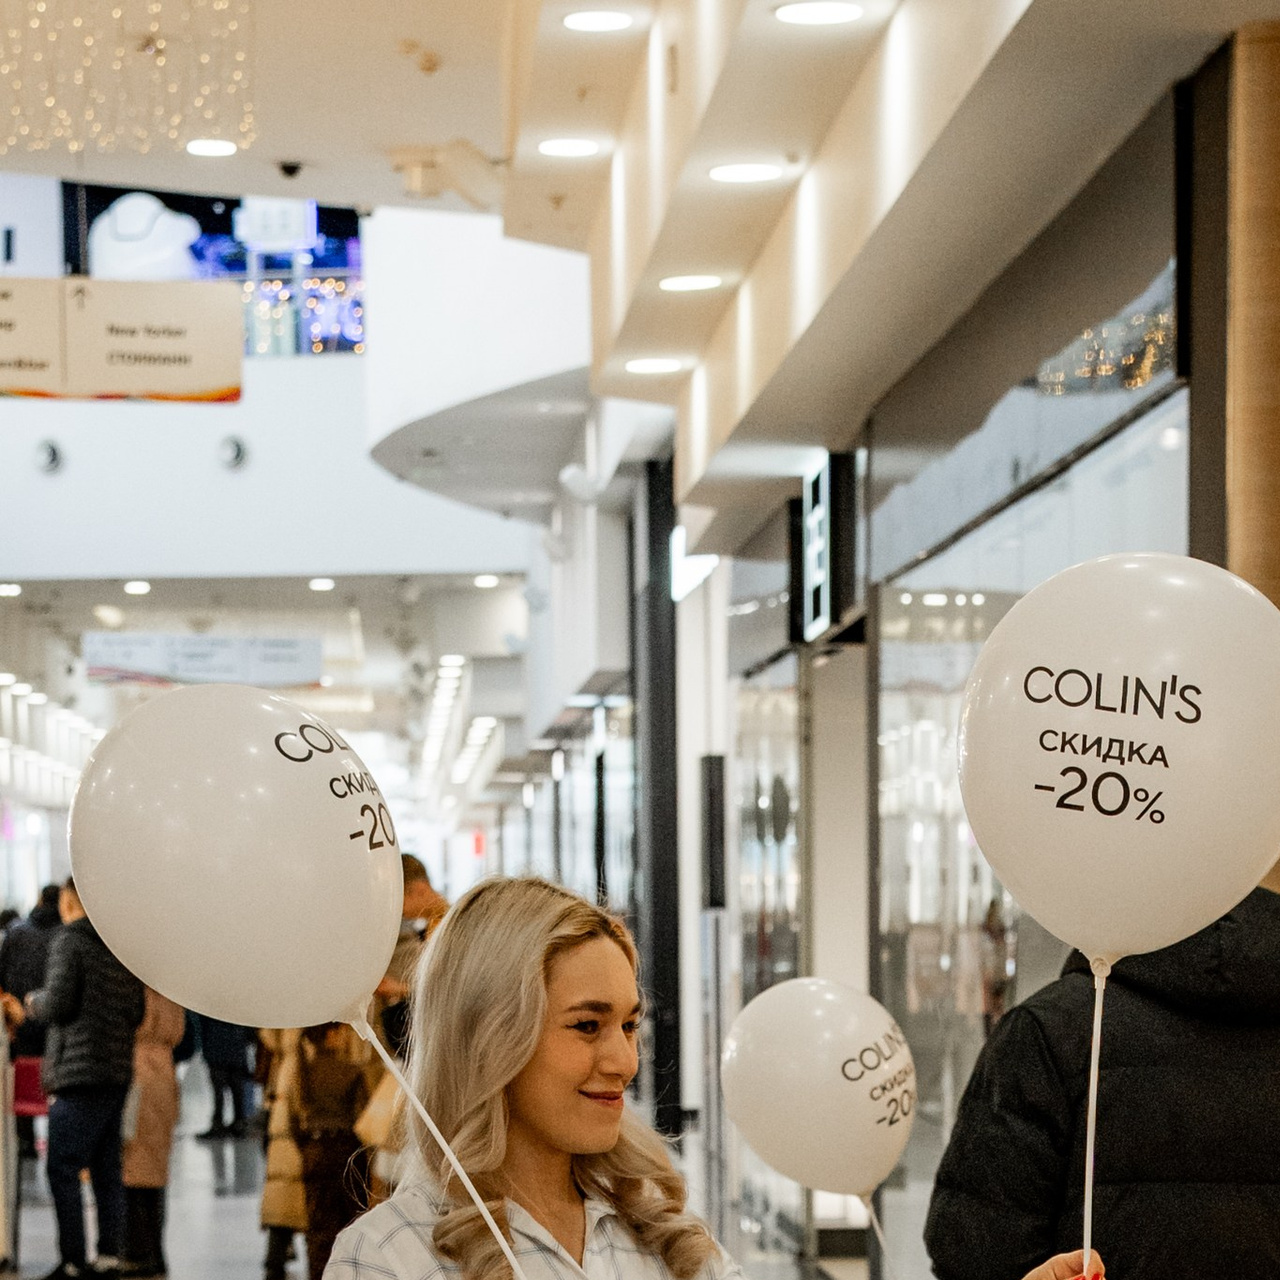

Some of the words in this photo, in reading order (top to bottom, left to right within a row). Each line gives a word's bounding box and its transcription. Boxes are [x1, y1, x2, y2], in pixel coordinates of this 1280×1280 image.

[1023, 665, 1203, 724] COLIN'S
[1038, 729, 1170, 769] СКИДКА
[1034, 766, 1166, 824] -20%
